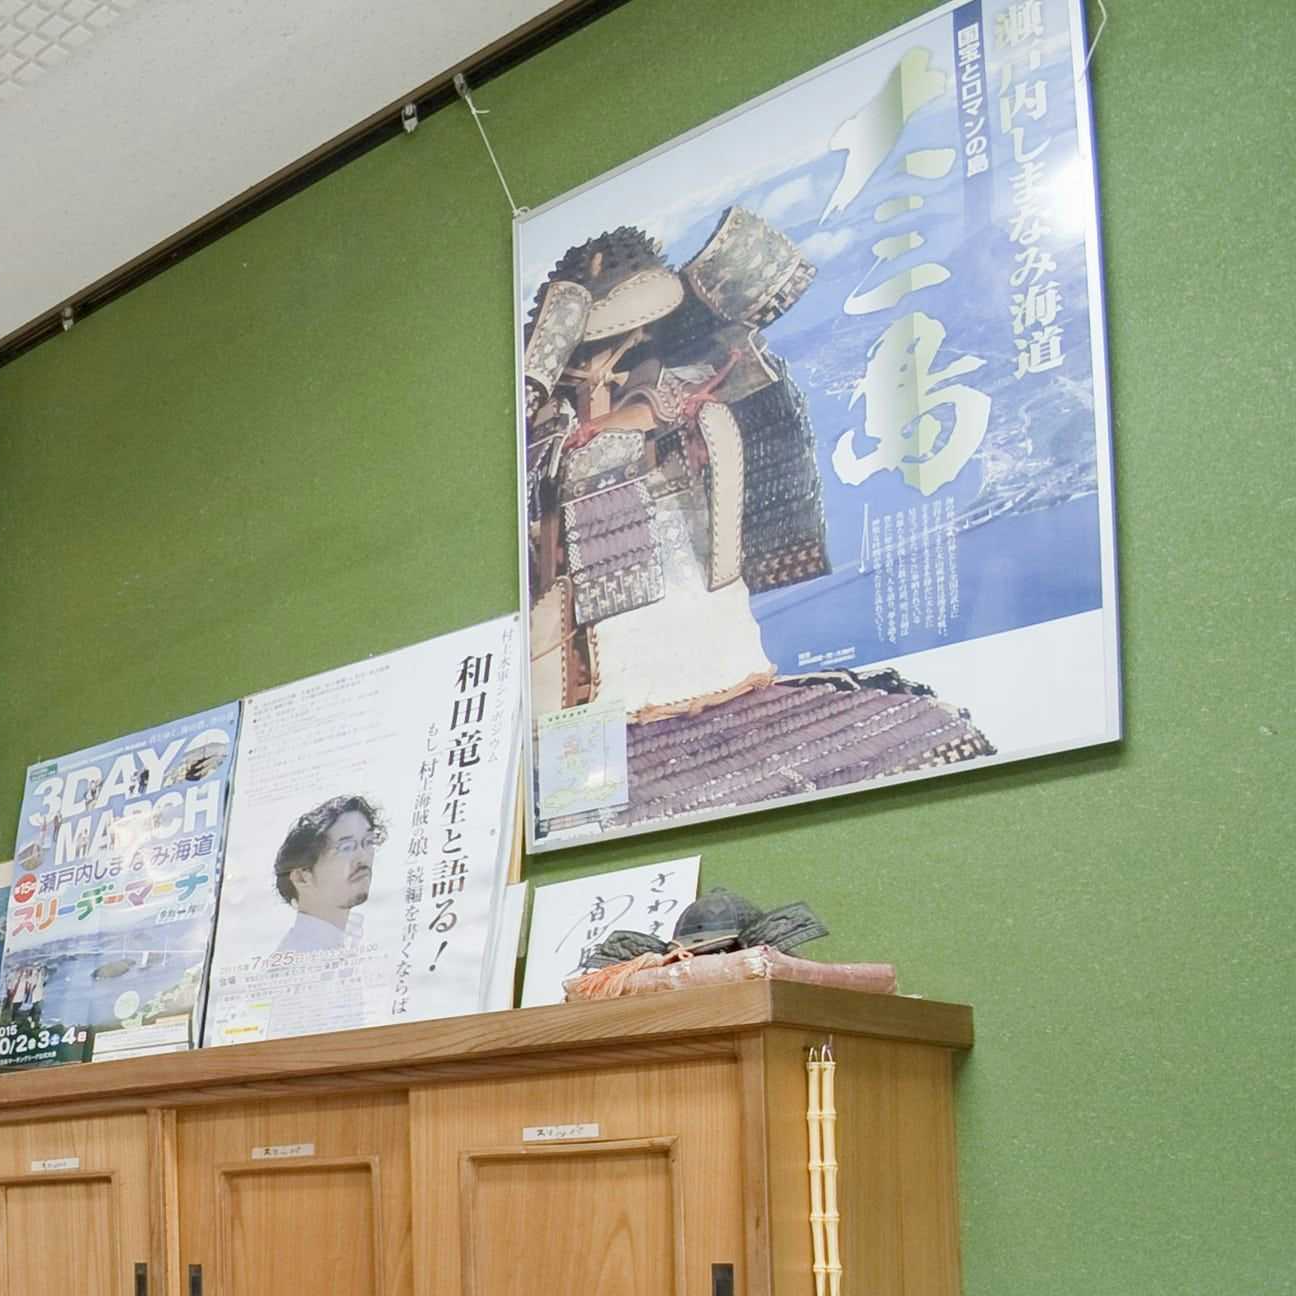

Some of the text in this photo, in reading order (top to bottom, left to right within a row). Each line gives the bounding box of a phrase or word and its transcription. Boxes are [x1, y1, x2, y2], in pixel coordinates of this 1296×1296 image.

[819, 46, 992, 498] 大三島
[12, 872, 209, 937] スリーデーマーチ
[37, 833, 215, 896] 瀬戸内しまなみ海道
[428, 652, 493, 973] 和田竜先生と語る！
